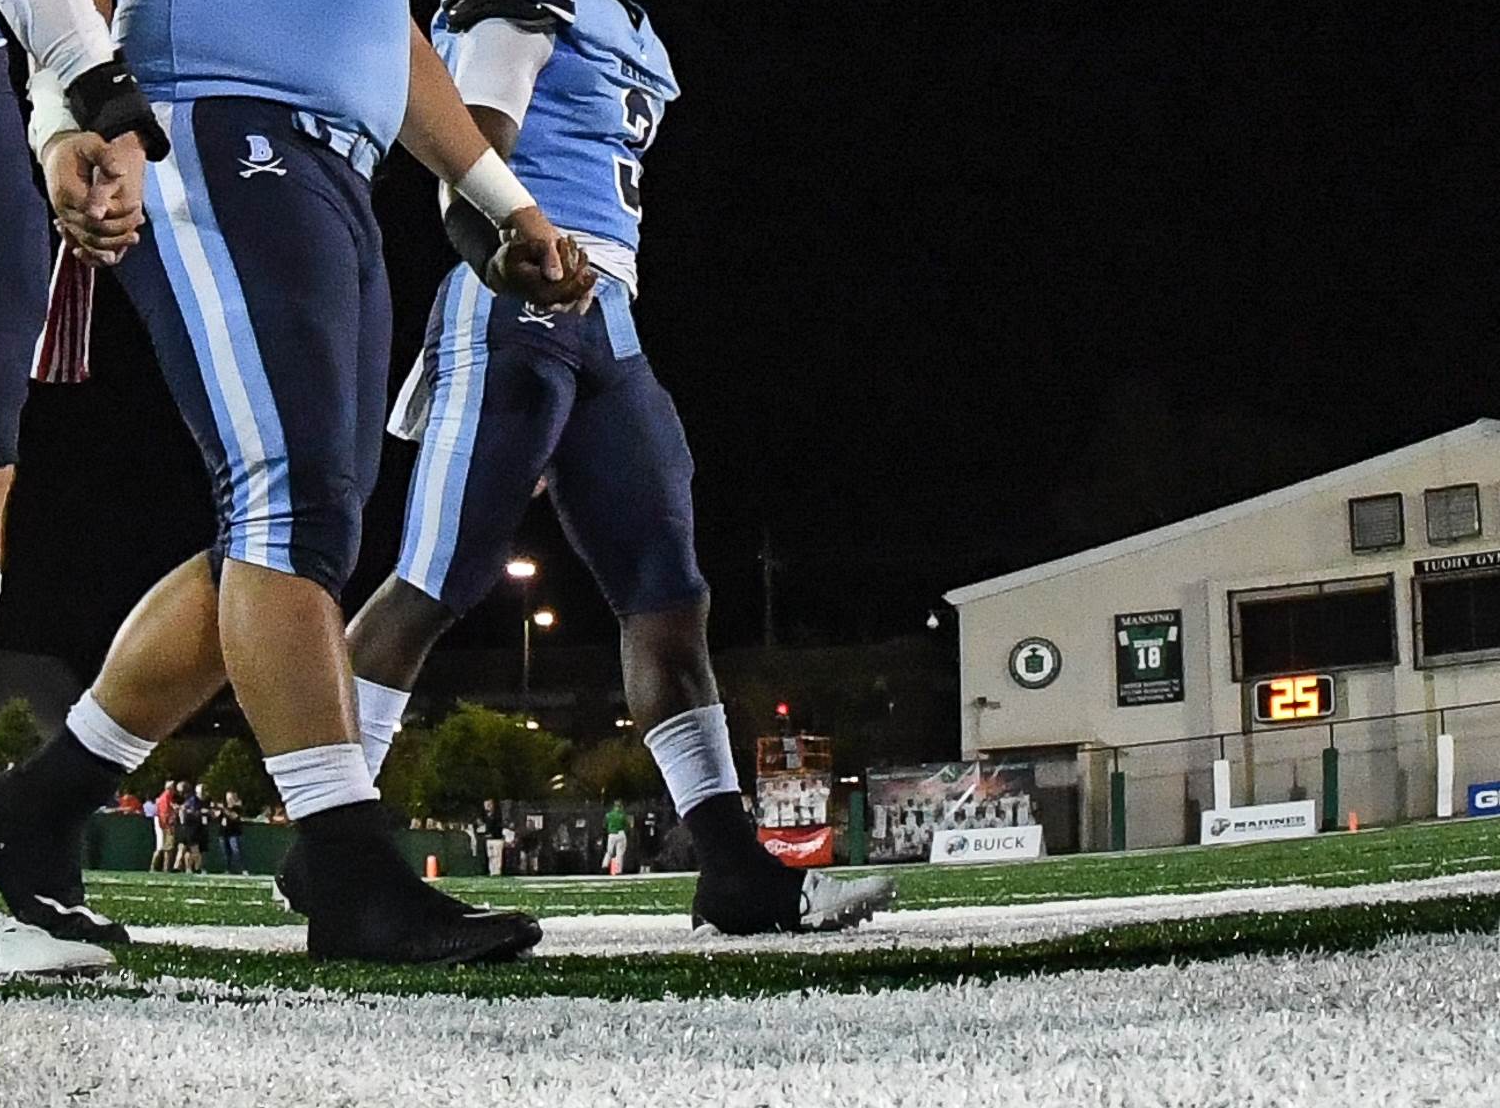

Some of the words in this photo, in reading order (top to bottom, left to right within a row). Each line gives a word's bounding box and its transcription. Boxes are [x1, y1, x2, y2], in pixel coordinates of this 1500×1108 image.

[245, 134, 274, 162] B
[612, 87, 658, 225] 3
[1422, 556, 1470, 572] TUOHY
[1120, 613, 1175, 626] MANNING
[1136, 646, 1161, 670] 18
[1270, 675, 1319, 720] 25
[1474, 790, 1500, 809] G
[974, 835, 1027, 852] BUICK
